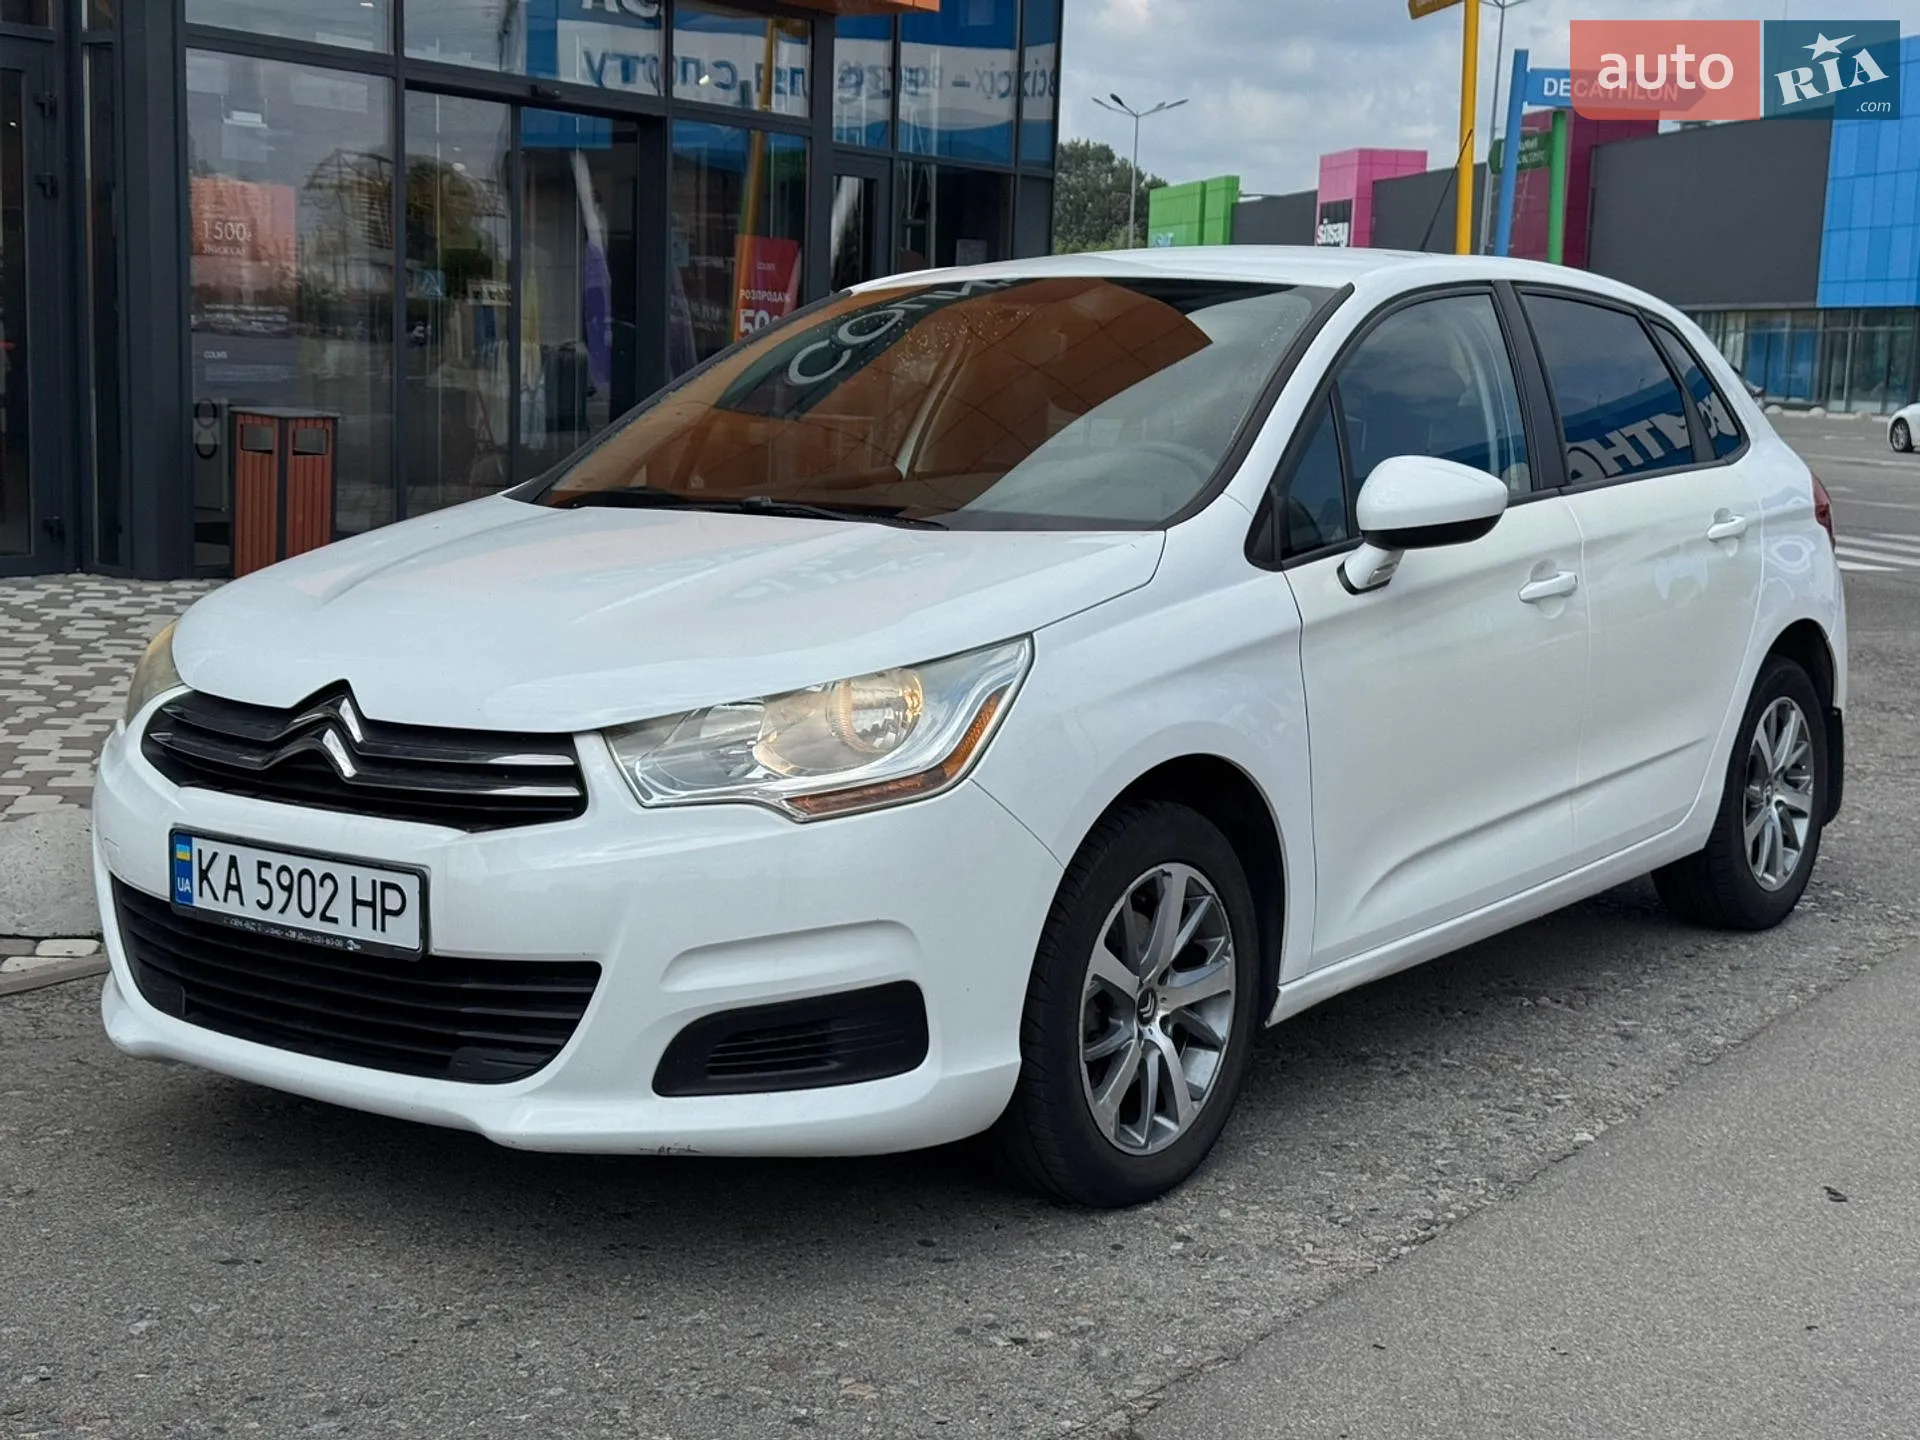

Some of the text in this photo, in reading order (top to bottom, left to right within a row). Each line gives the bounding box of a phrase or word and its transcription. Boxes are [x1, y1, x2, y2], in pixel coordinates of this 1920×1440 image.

[740, 309, 782, 334] 50
[177, 877, 192, 893] UA
[197, 848, 407, 932] KA 5902 HP
